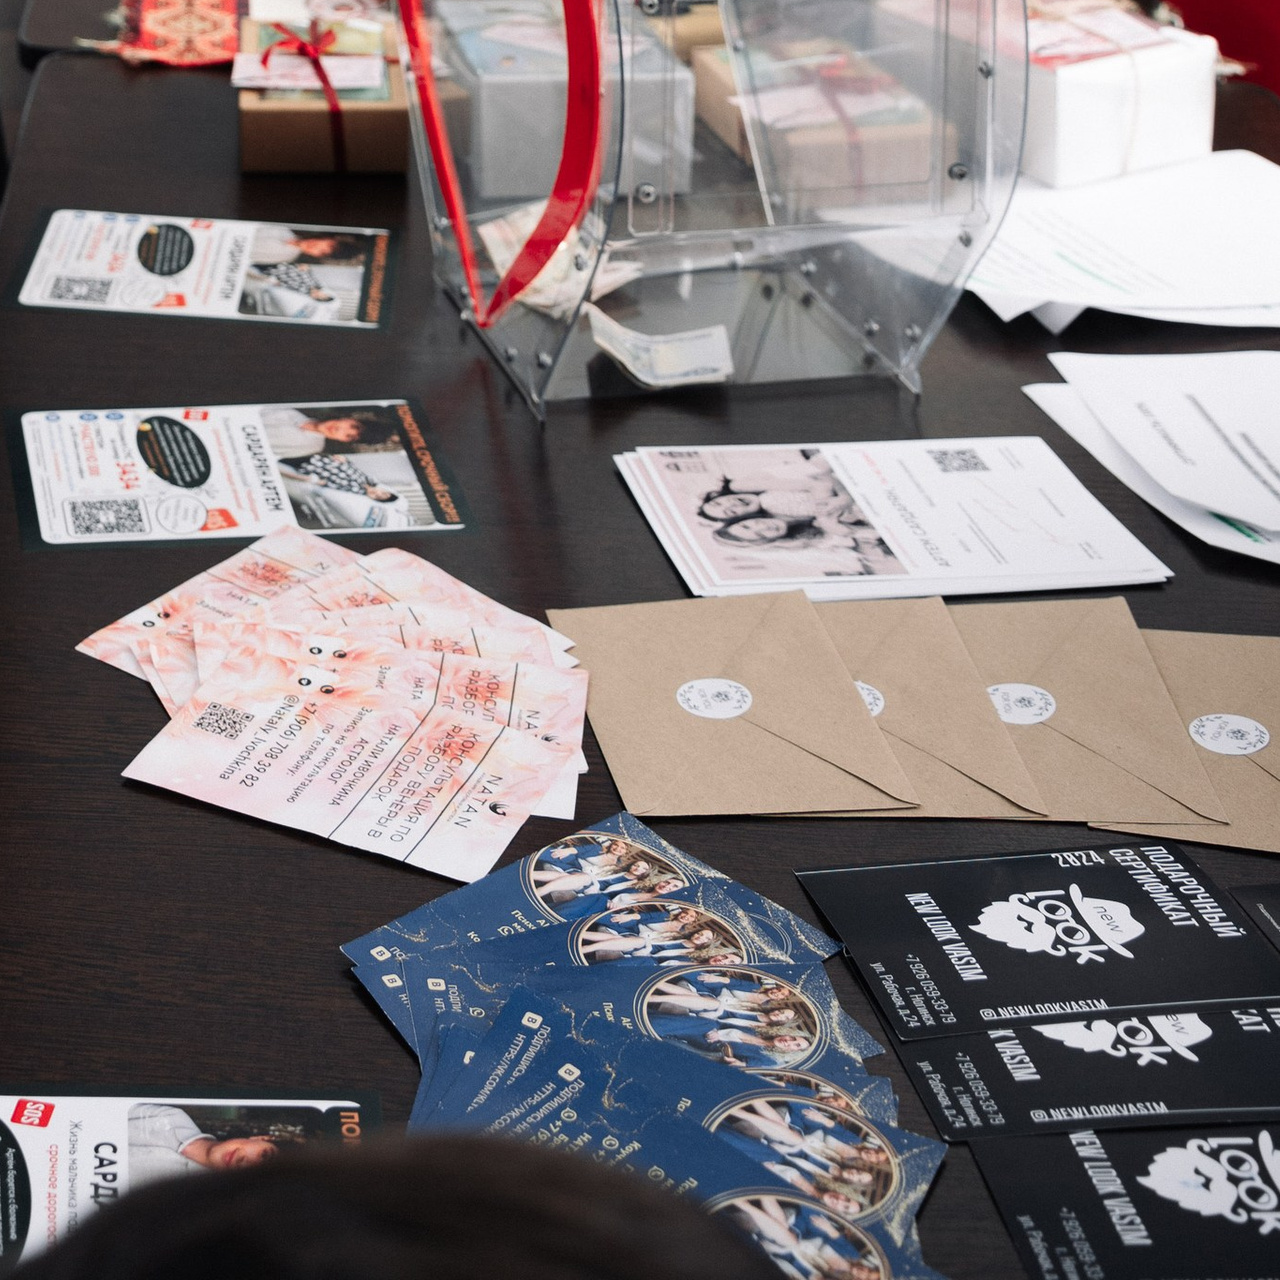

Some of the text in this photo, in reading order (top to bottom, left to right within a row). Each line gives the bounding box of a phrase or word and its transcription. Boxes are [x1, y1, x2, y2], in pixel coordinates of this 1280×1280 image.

[239, 702, 318, 788] +7 (906) 708 39 82
[323, 723, 334, 734] по
[286, 706, 373, 804] Запись на консультацию
[327, 737, 369, 785] АСТРОЛОГ
[329, 723, 402, 806] НАТАЛИ ИВОЧКИНА
[372, 746, 422, 801] ПОДАРОК
[404, 733, 481, 823] КОНСУЛЬТАЦИЯ
[367, 724, 462, 838] РАЗБОРУ ВЕНЕРЫ В
[454, 774, 503, 829] NATAN
[390, 825, 411, 842] ПО
[1052, 850, 1105, 868] 2024
[1109, 848, 1199, 927] СЕРТИФИКАТ
[1140, 846, 1247, 938] ПОДАРОЧНЫЙ
[905, 892, 988, 981] NEW LOOK VASIM
[1093, 905, 1124, 933] new
[869, 962, 886, 974] ул.
[906, 954, 957, 1024] +7 926 059-33-79
[910, 993, 936, 1026] Ногинск
[1166, 1015, 1189, 1035] ew
[513, 1024, 551, 1077] ПОДПИШИСЬ
[995, 1039, 1041, 1081] VASIM
[20, 1101, 46, 1125] SOS
[528, 1079, 585, 1122] ПОДПИШИСЬ
[959, 1061, 978, 1079] 926
[969, 1079, 1005, 1125] 059-33-79
[68, 1120, 82, 1155] Жизнь
[46, 1144, 58, 1189] срочное
[67, 1158, 78, 1208] мальчика
[90, 1142, 118, 1205] САРД
[1084, 1162, 1127, 1196] LOOK
[1103, 1197, 1152, 1245] VASIM
